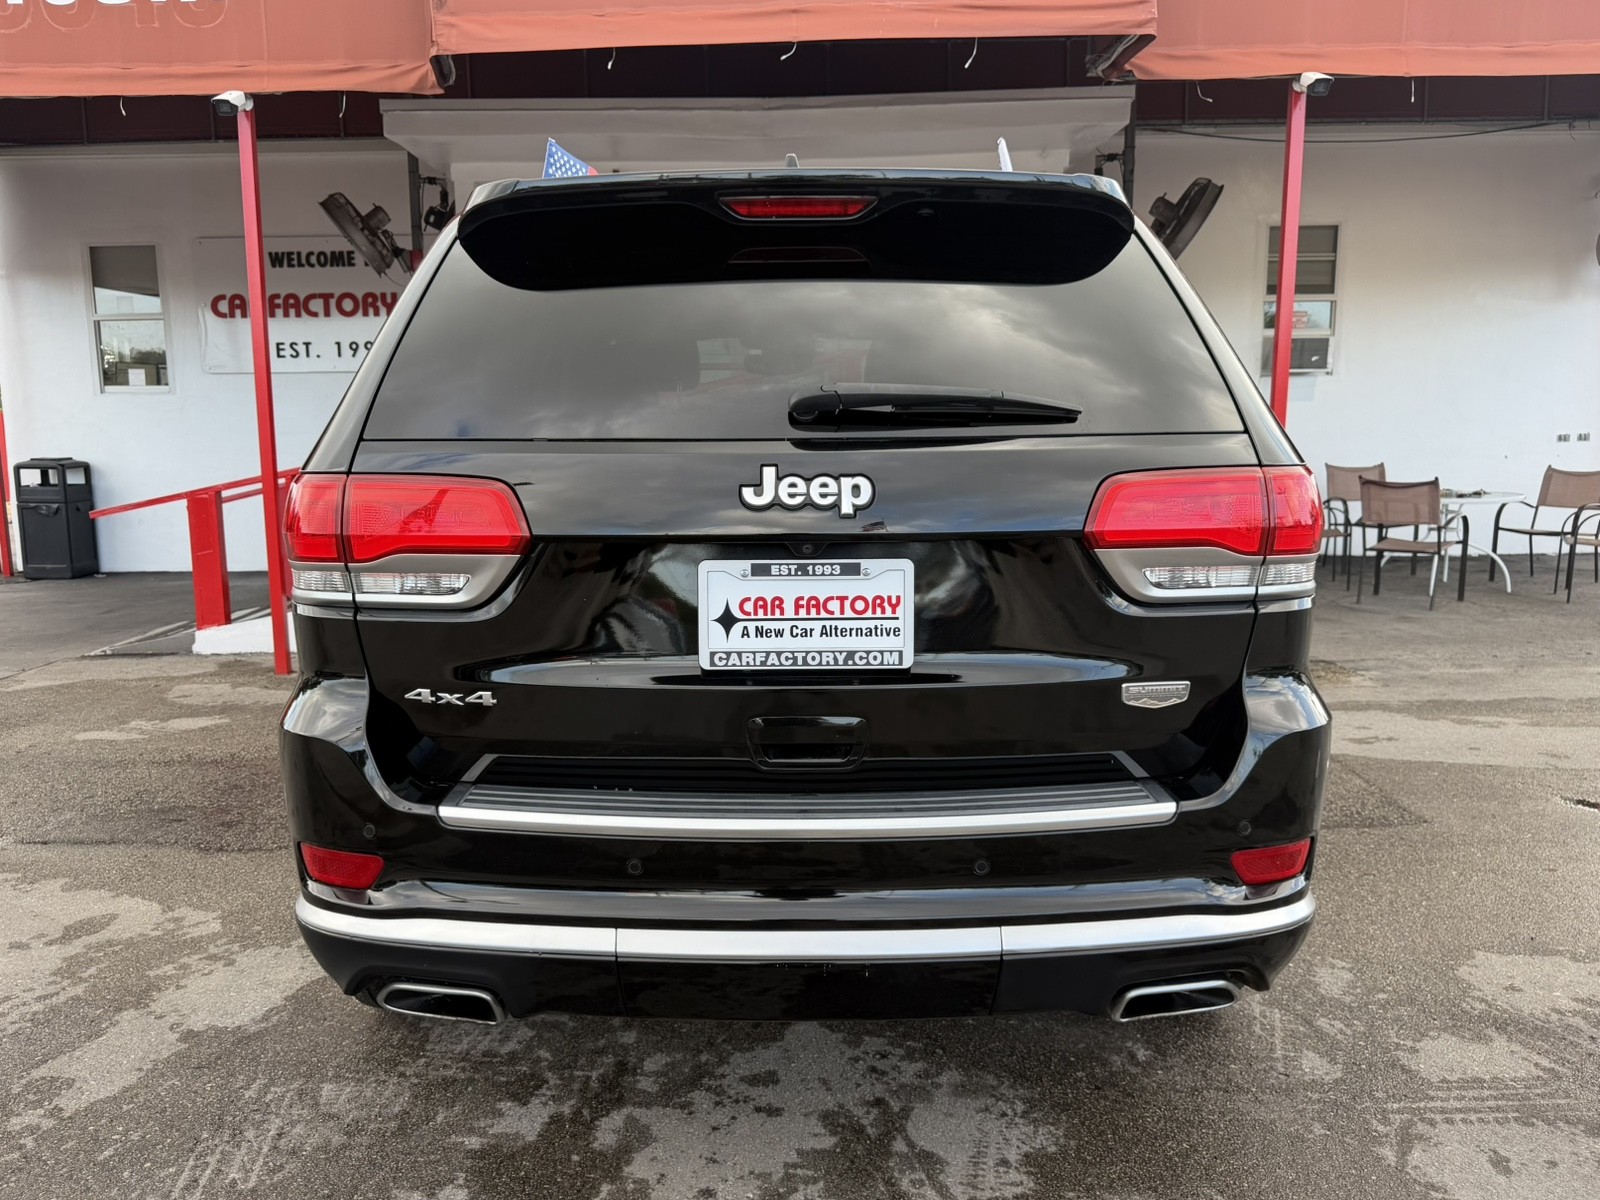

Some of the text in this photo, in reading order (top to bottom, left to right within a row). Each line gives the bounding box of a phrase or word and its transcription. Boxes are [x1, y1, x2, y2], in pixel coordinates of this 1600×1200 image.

[268, 250, 356, 269] WELCOME
[210, 291, 398, 319] CA FACTORY
[275, 340, 374, 359] EST. 199
[739, 464, 875, 518] Jeep
[770, 564, 841, 576] EST. 1993
[738, 594, 902, 617] CAR FACTORY
[740, 623, 901, 639] A New Car Alternative
[713, 651, 900, 667] CARFACTORY.COM
[404, 688, 498, 707] 4x4
